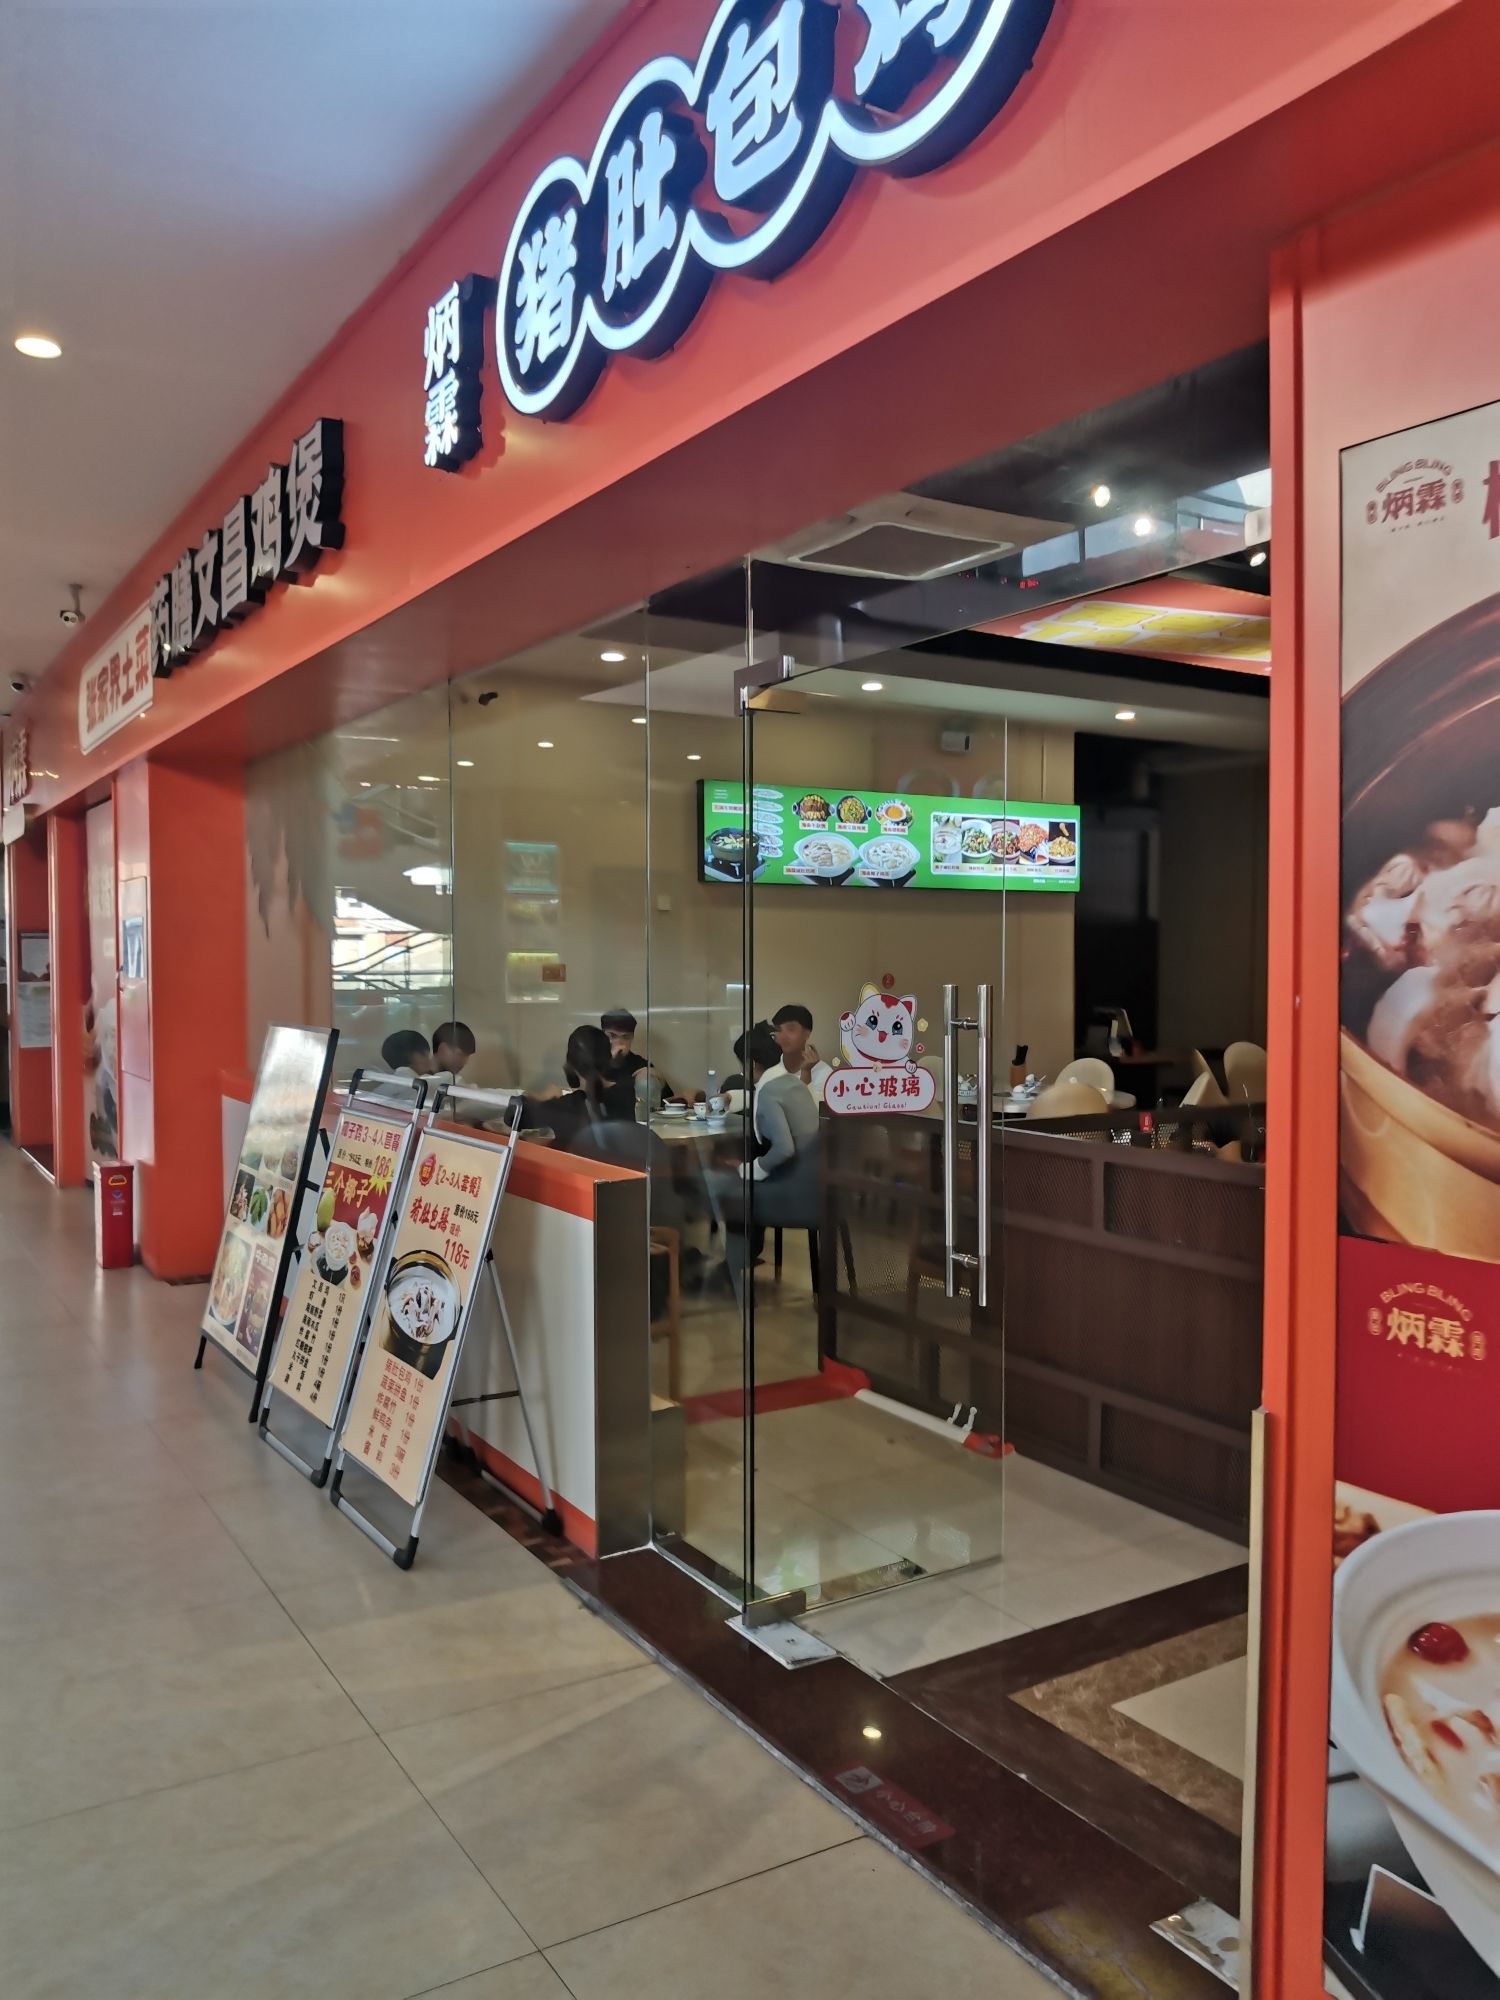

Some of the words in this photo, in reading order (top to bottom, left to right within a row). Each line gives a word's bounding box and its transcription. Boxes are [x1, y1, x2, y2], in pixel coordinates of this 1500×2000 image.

[423, 280, 460, 467] 炳霖
[1381, 478, 1447, 524] 炳霖
[832, 1074, 921, 1098] 小心玻璃
[444, 1238, 470, 1270] 118元
[1386, 1306, 1465, 1358] 炳霖
